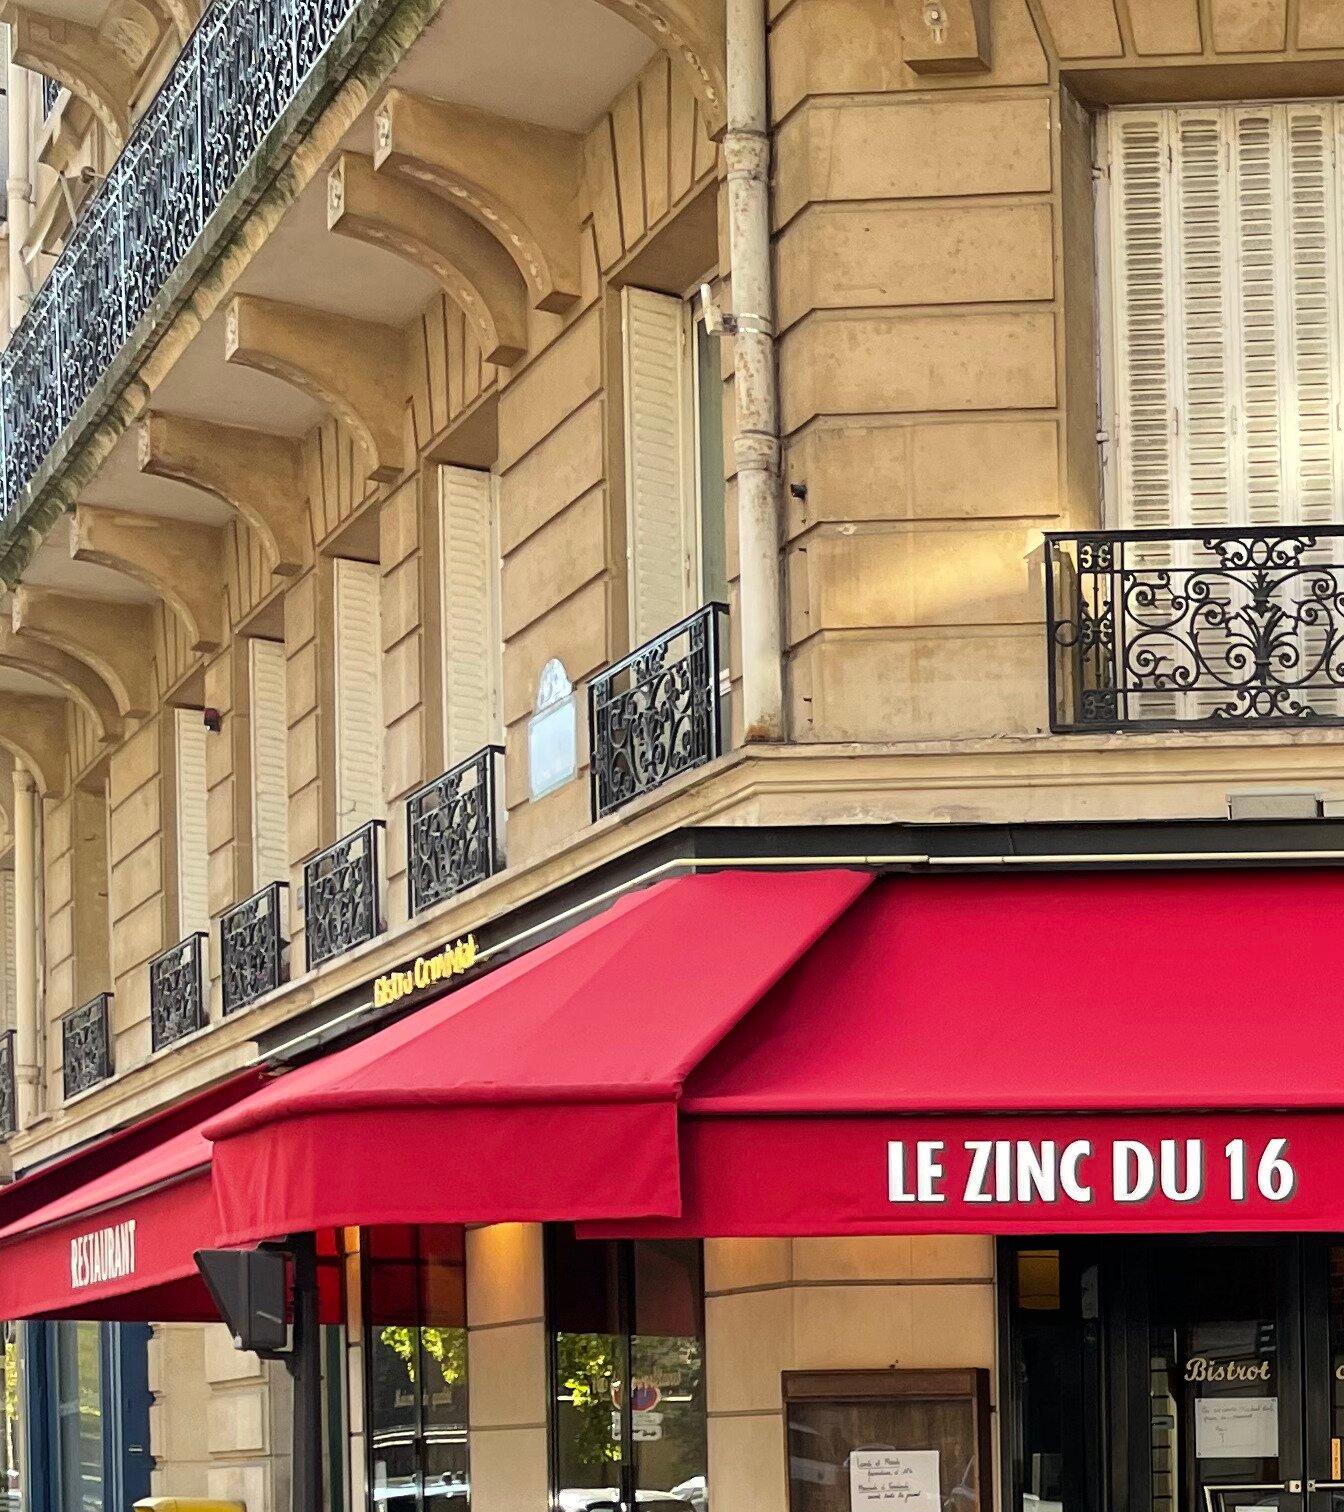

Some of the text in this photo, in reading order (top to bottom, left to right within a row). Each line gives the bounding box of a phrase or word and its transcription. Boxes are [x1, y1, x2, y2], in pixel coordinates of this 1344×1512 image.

[888, 1138, 1295, 1202] LE ZINC DU 16
[71, 1219, 136, 1289] RESTAURANT
[1184, 1357, 1271, 1382] Bistrot
